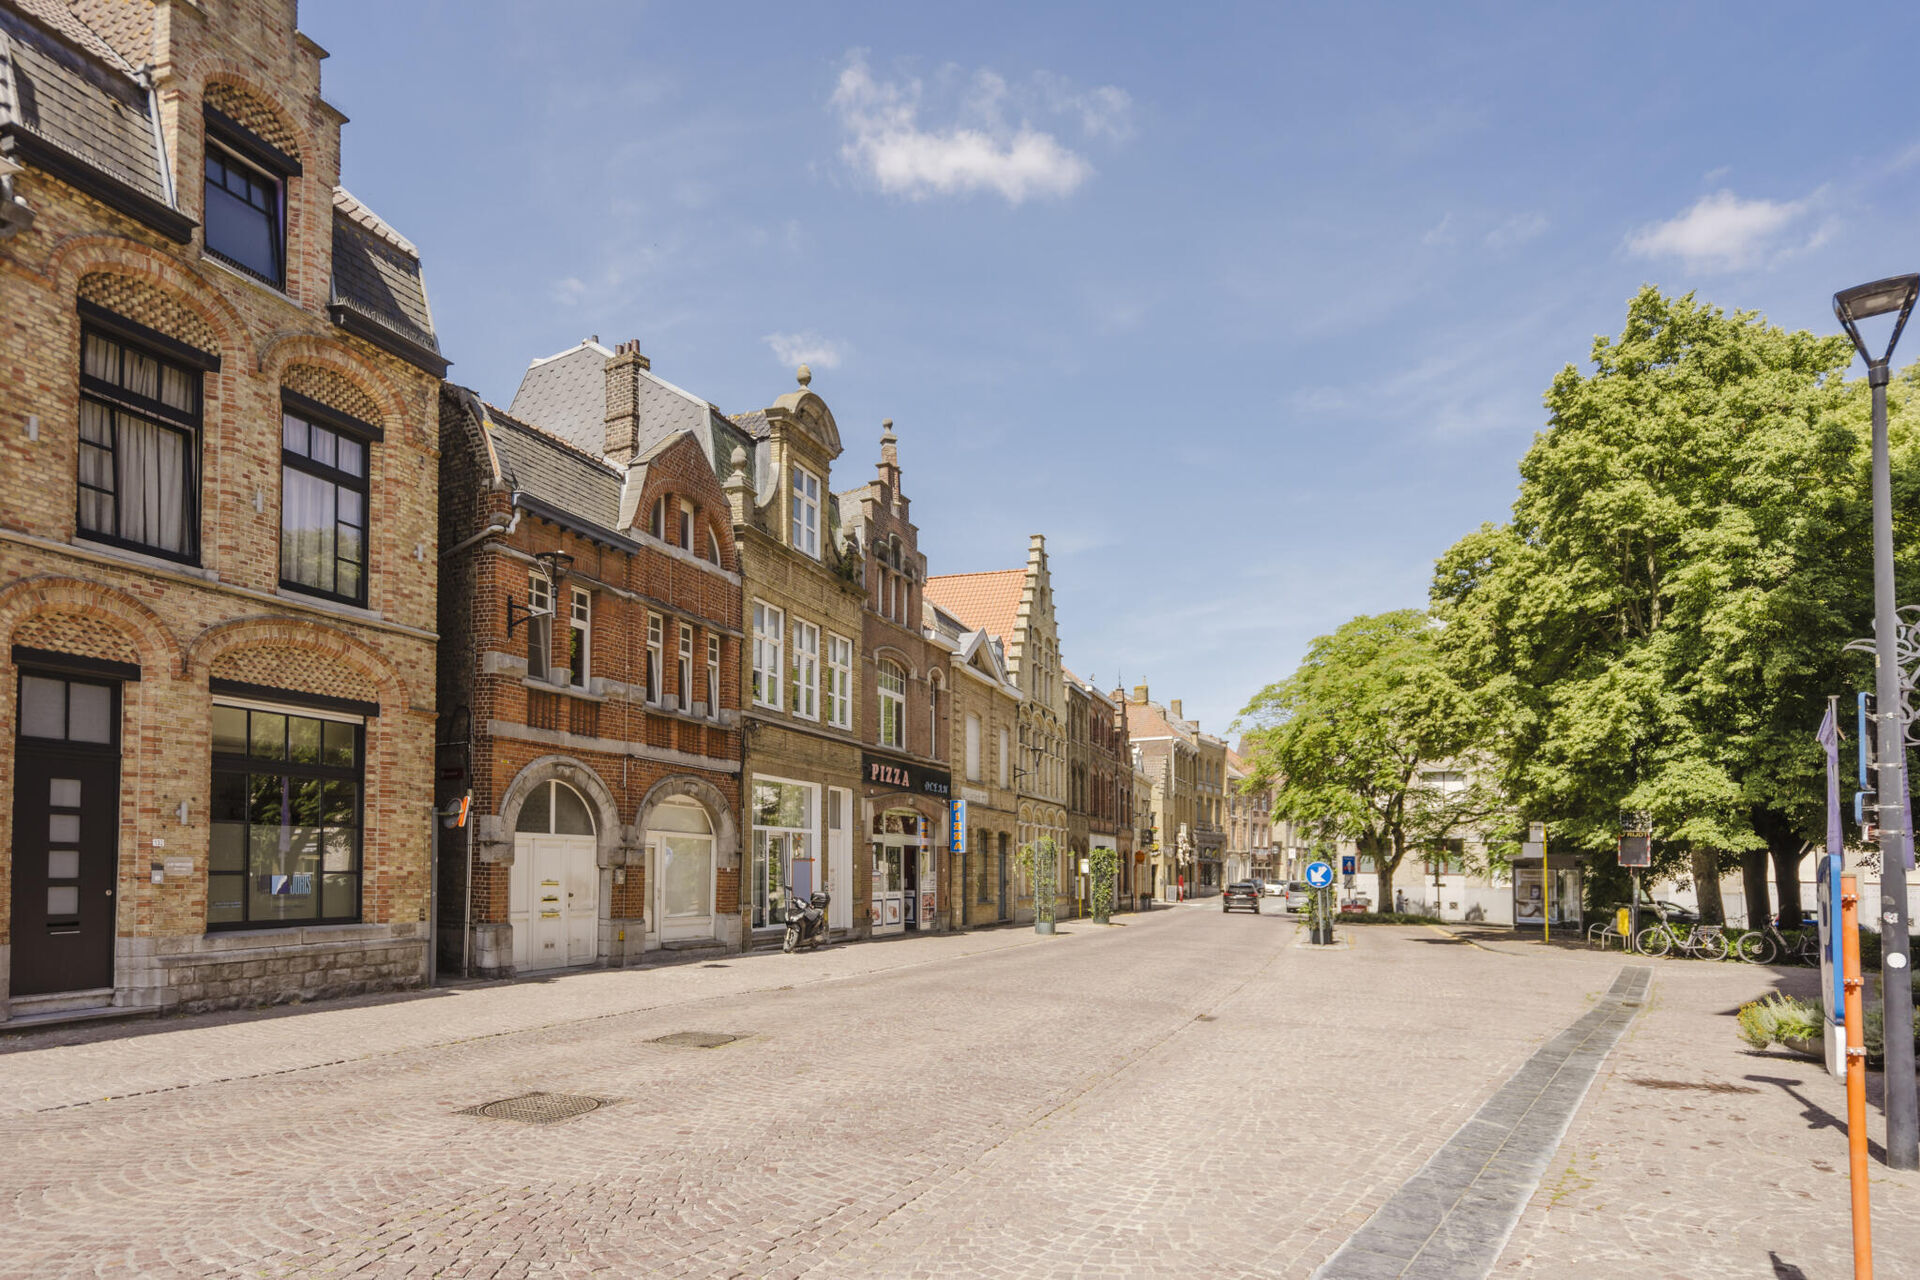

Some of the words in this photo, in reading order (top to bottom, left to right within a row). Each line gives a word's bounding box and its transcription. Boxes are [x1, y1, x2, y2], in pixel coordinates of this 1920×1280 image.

[871, 763, 909, 787] PIZZA
[925, 781, 949, 794] OCEAN
[953, 802, 962, 850] PIZZA
